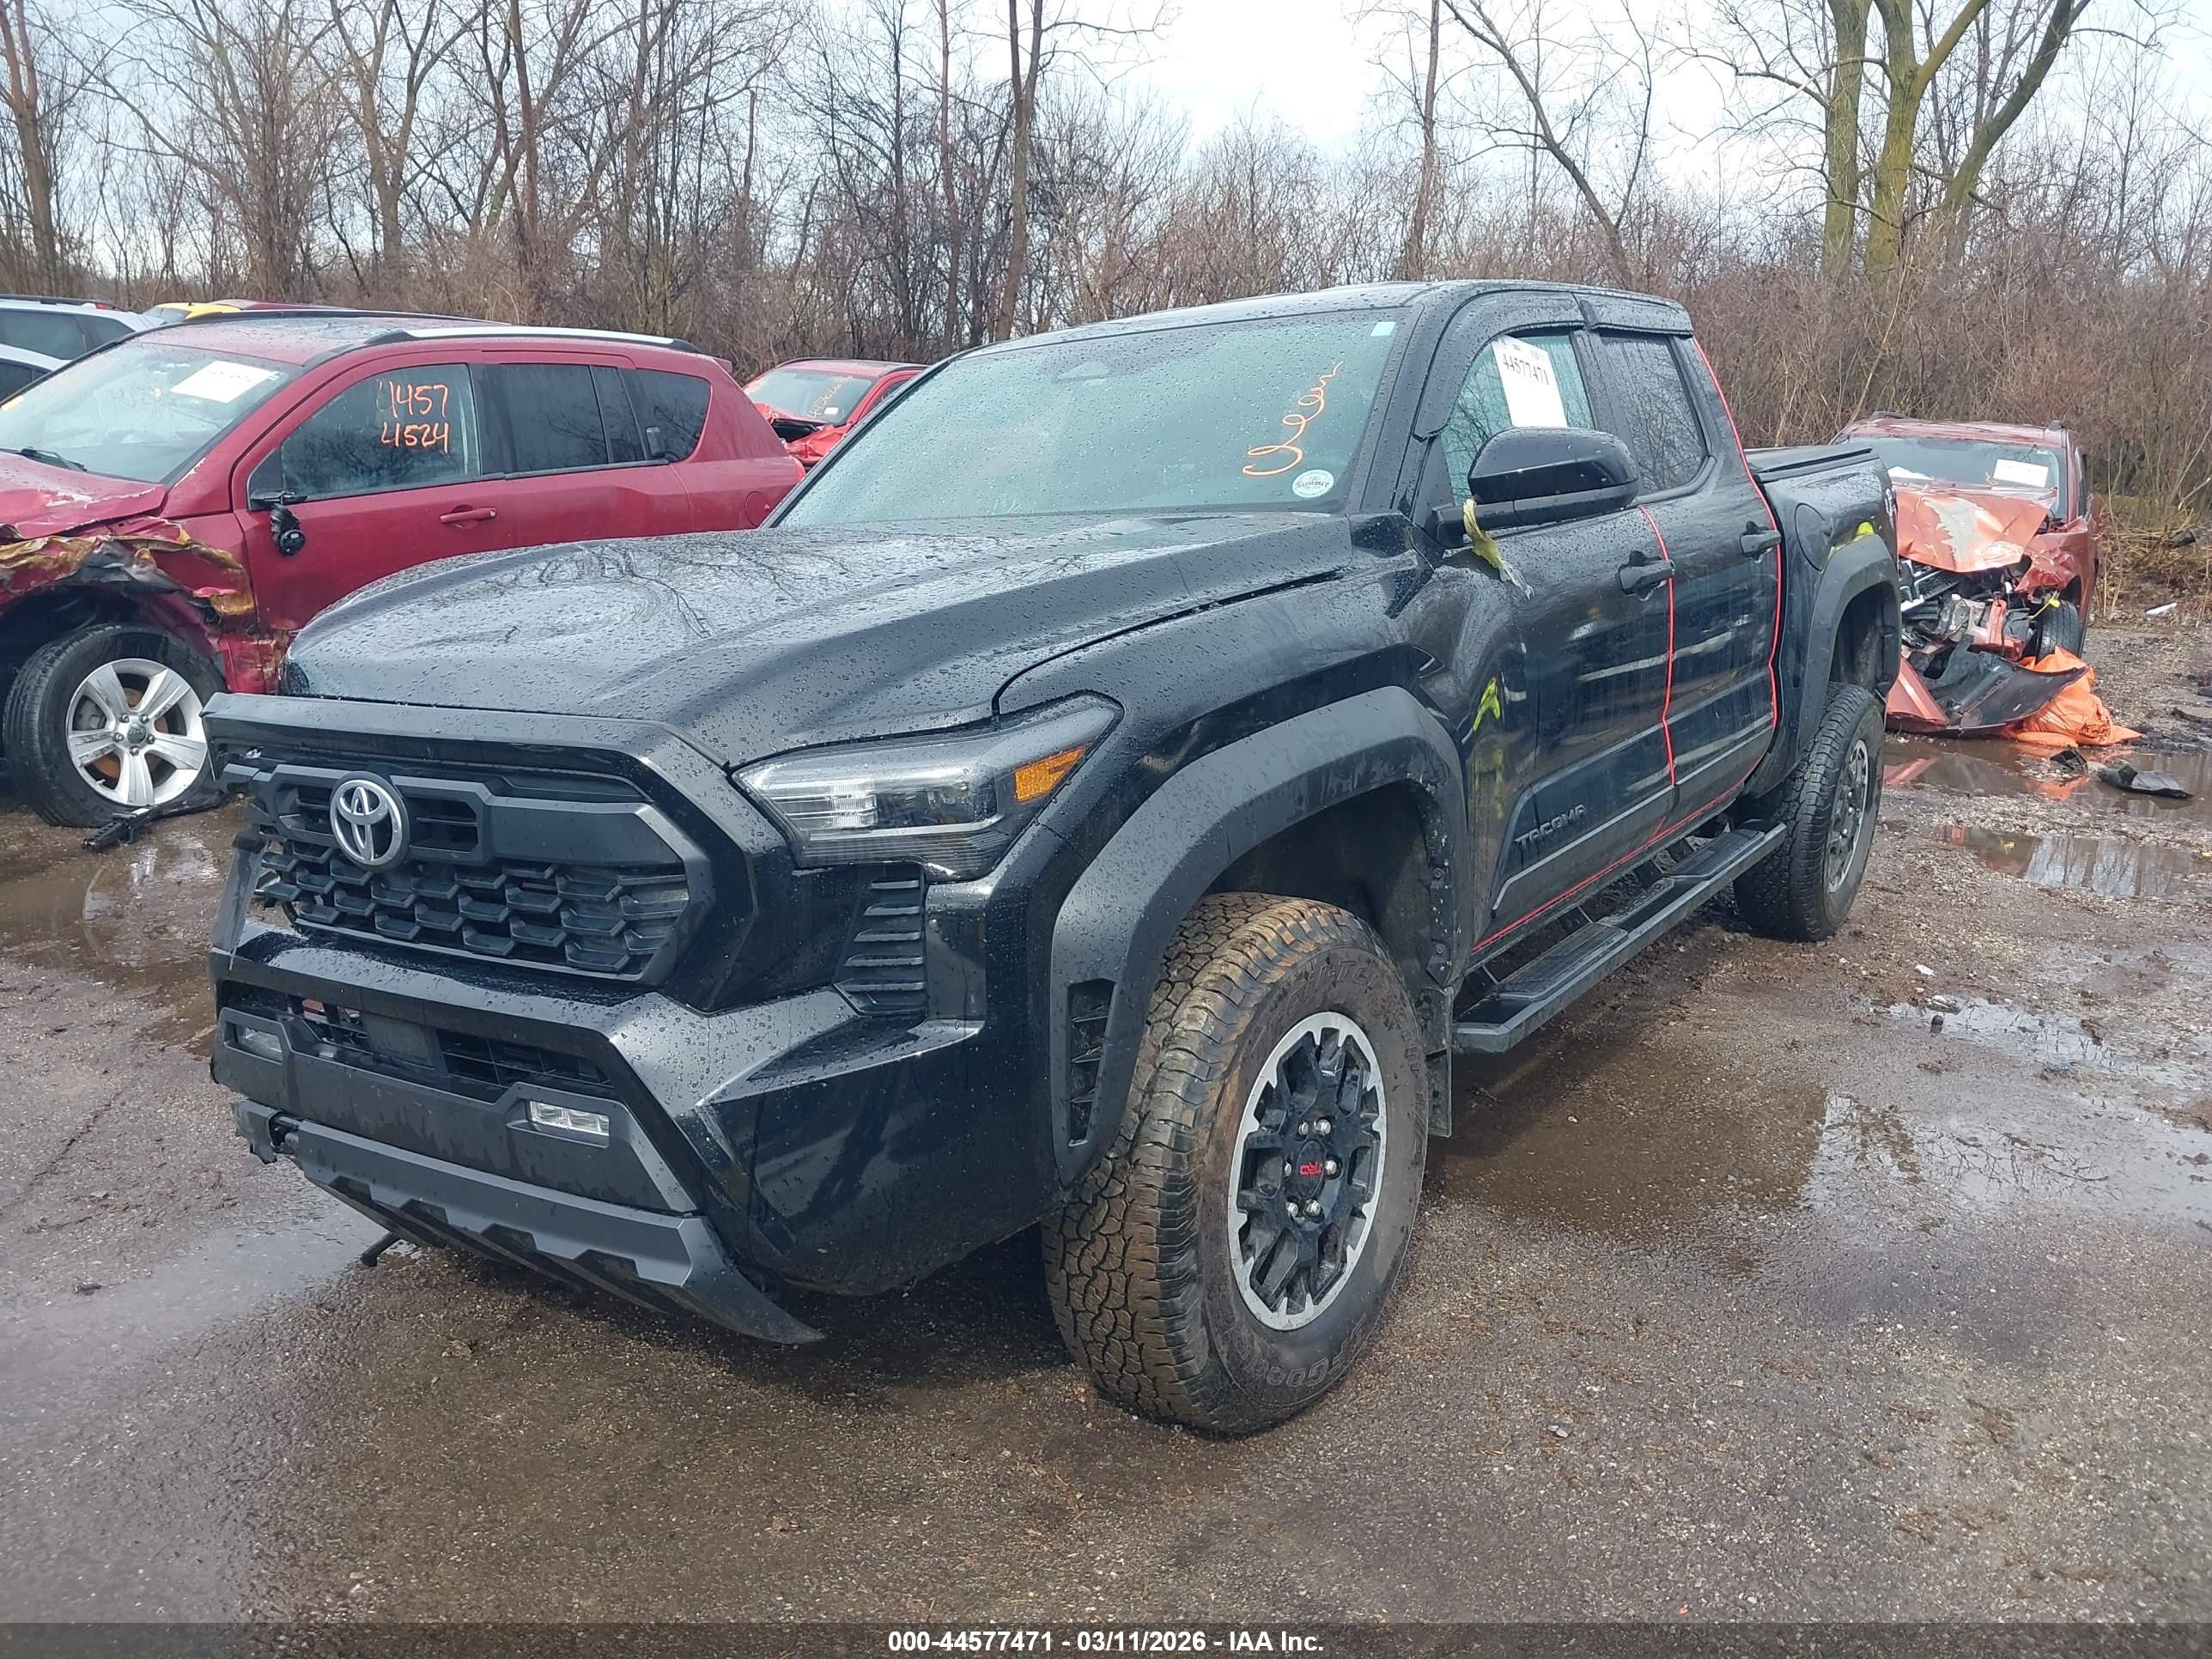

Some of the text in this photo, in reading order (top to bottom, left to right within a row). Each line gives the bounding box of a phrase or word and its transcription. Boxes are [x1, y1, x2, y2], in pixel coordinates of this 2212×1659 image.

[1503, 352, 1549, 386] 44577471
[381, 422, 448, 454] 4524
[1514, 804, 1586, 846] TACOMA
